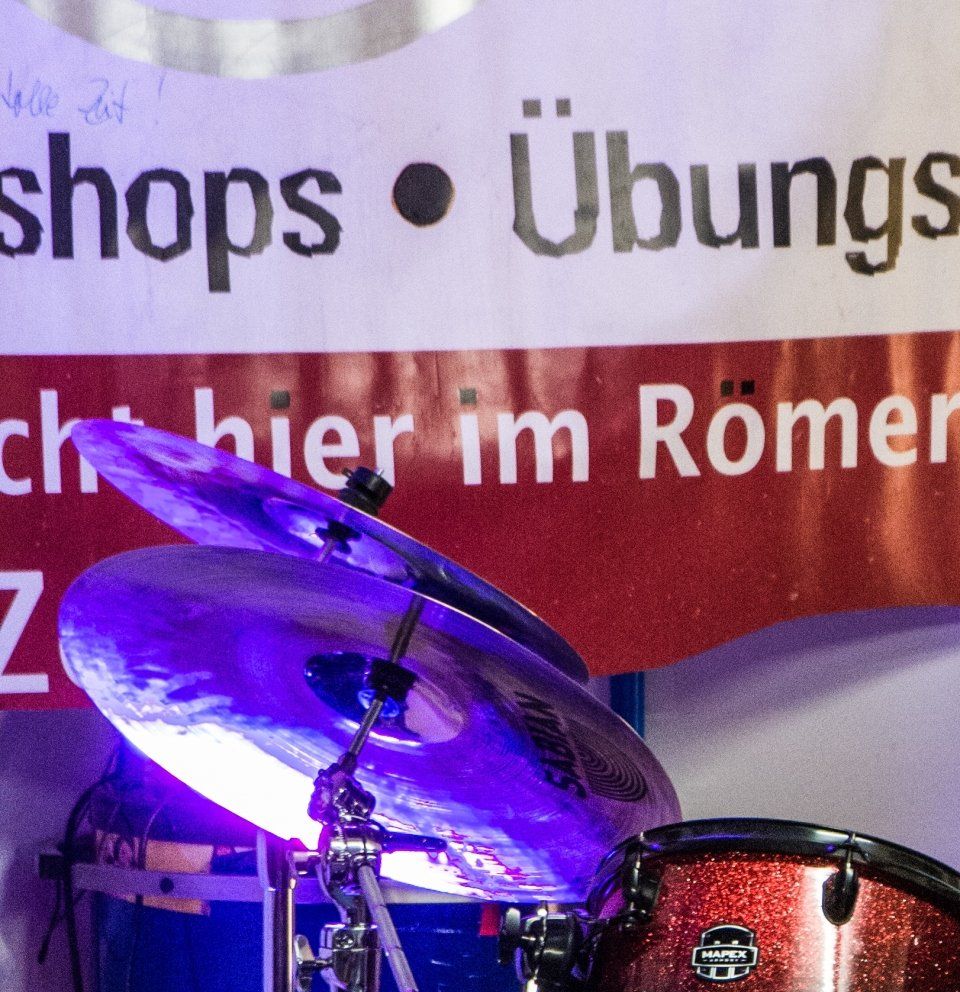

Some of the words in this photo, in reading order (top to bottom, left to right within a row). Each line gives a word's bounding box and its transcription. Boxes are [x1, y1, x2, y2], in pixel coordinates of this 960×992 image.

[0, 132, 343, 293] shops
[460, 388, 590, 486] im
[701, 949, 748, 959] MAPEX
